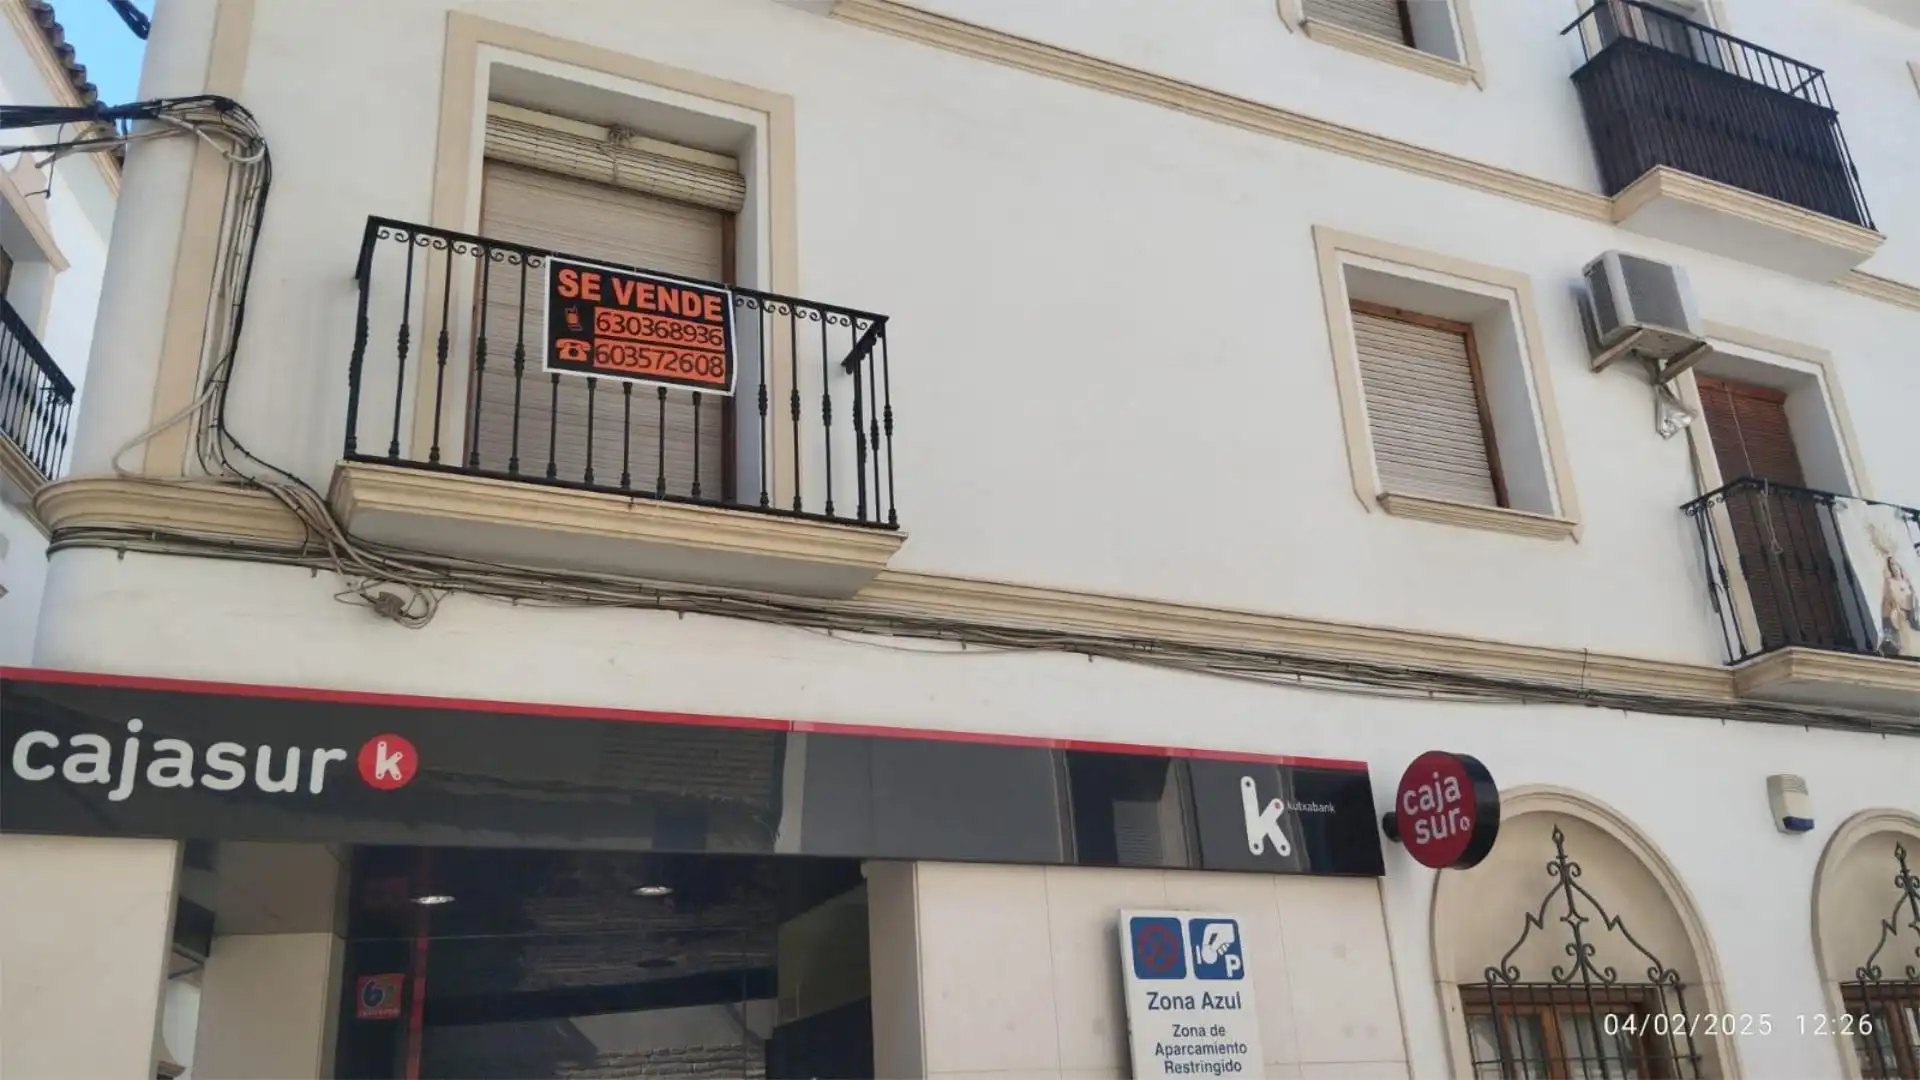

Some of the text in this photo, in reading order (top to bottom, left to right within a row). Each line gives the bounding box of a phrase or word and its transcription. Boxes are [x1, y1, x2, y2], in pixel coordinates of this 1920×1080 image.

[557, 268, 724, 322] SE VENDE
[596, 311, 723, 346] 630368936
[595, 343, 724, 378] 603572608
[12, 717, 348, 801] cajasur
[1403, 771, 1462, 816] caja
[1146, 991, 1242, 1010] Zona Azul
[1172, 1024, 1226, 1038] Zona de
[1155, 1042, 1248, 1058] Aparcamiento
[1164, 1060, 1242, 1076] Restringido
